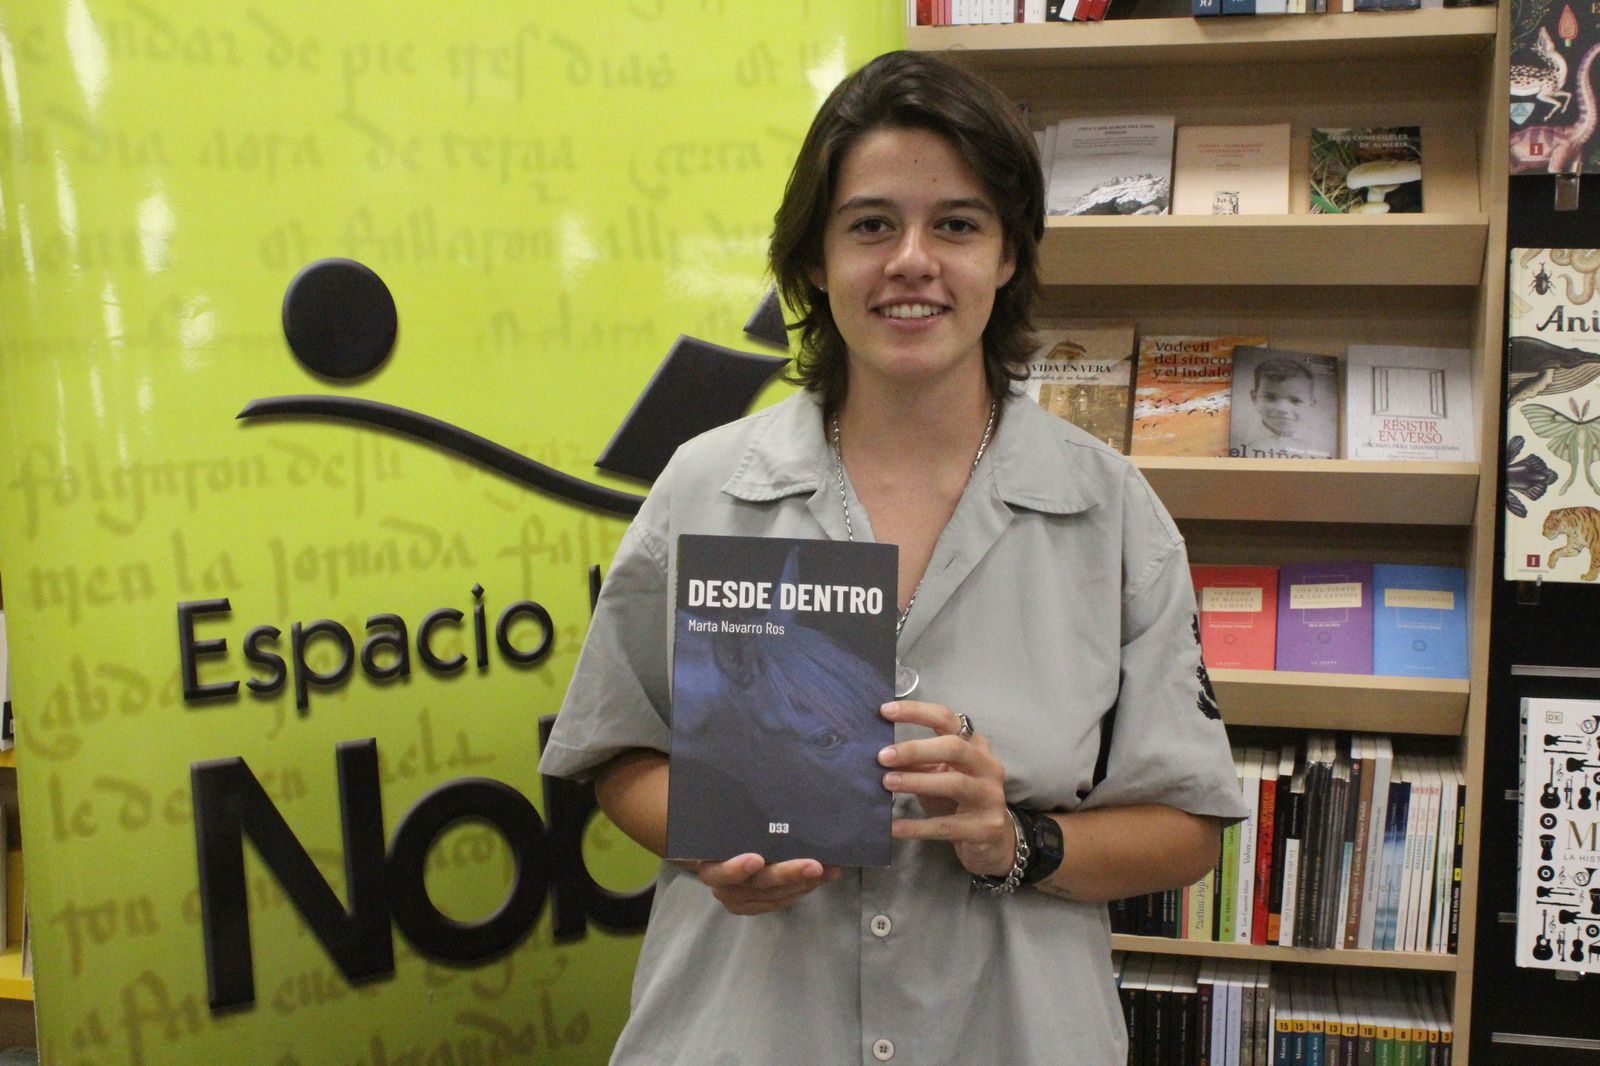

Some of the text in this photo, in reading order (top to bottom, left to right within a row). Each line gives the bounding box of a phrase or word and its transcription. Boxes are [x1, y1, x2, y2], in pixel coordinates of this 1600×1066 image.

[1155, 341, 1210, 353] Vodevil
[1154, 353, 1228, 365] del siroco
[1032, 364, 1059, 372] VIDA
[1079, 364, 1112, 373] VERA
[1152, 367, 1162, 379] y
[1164, 367, 1178, 377] el
[1378, 431, 1443, 444] EN VERSO
[688, 579, 883, 615] DESDE DENTRO
[688, 619, 785, 635] Marta Navarro Ros
[176, 583, 555, 713] Espacio
[1279, 1022, 1289, 1031] 15
[1295, 1022, 1304, 1031] 15
[1312, 1022, 1321, 1031] 14
[1329, 1025, 1338, 1033] 13
[1345, 1026, 1355, 1035] 12
[1417, 1031, 1423, 1040] 7
[1431, 1032, 1437, 1041] 3
[1444, 1032, 1450, 1041] 3
